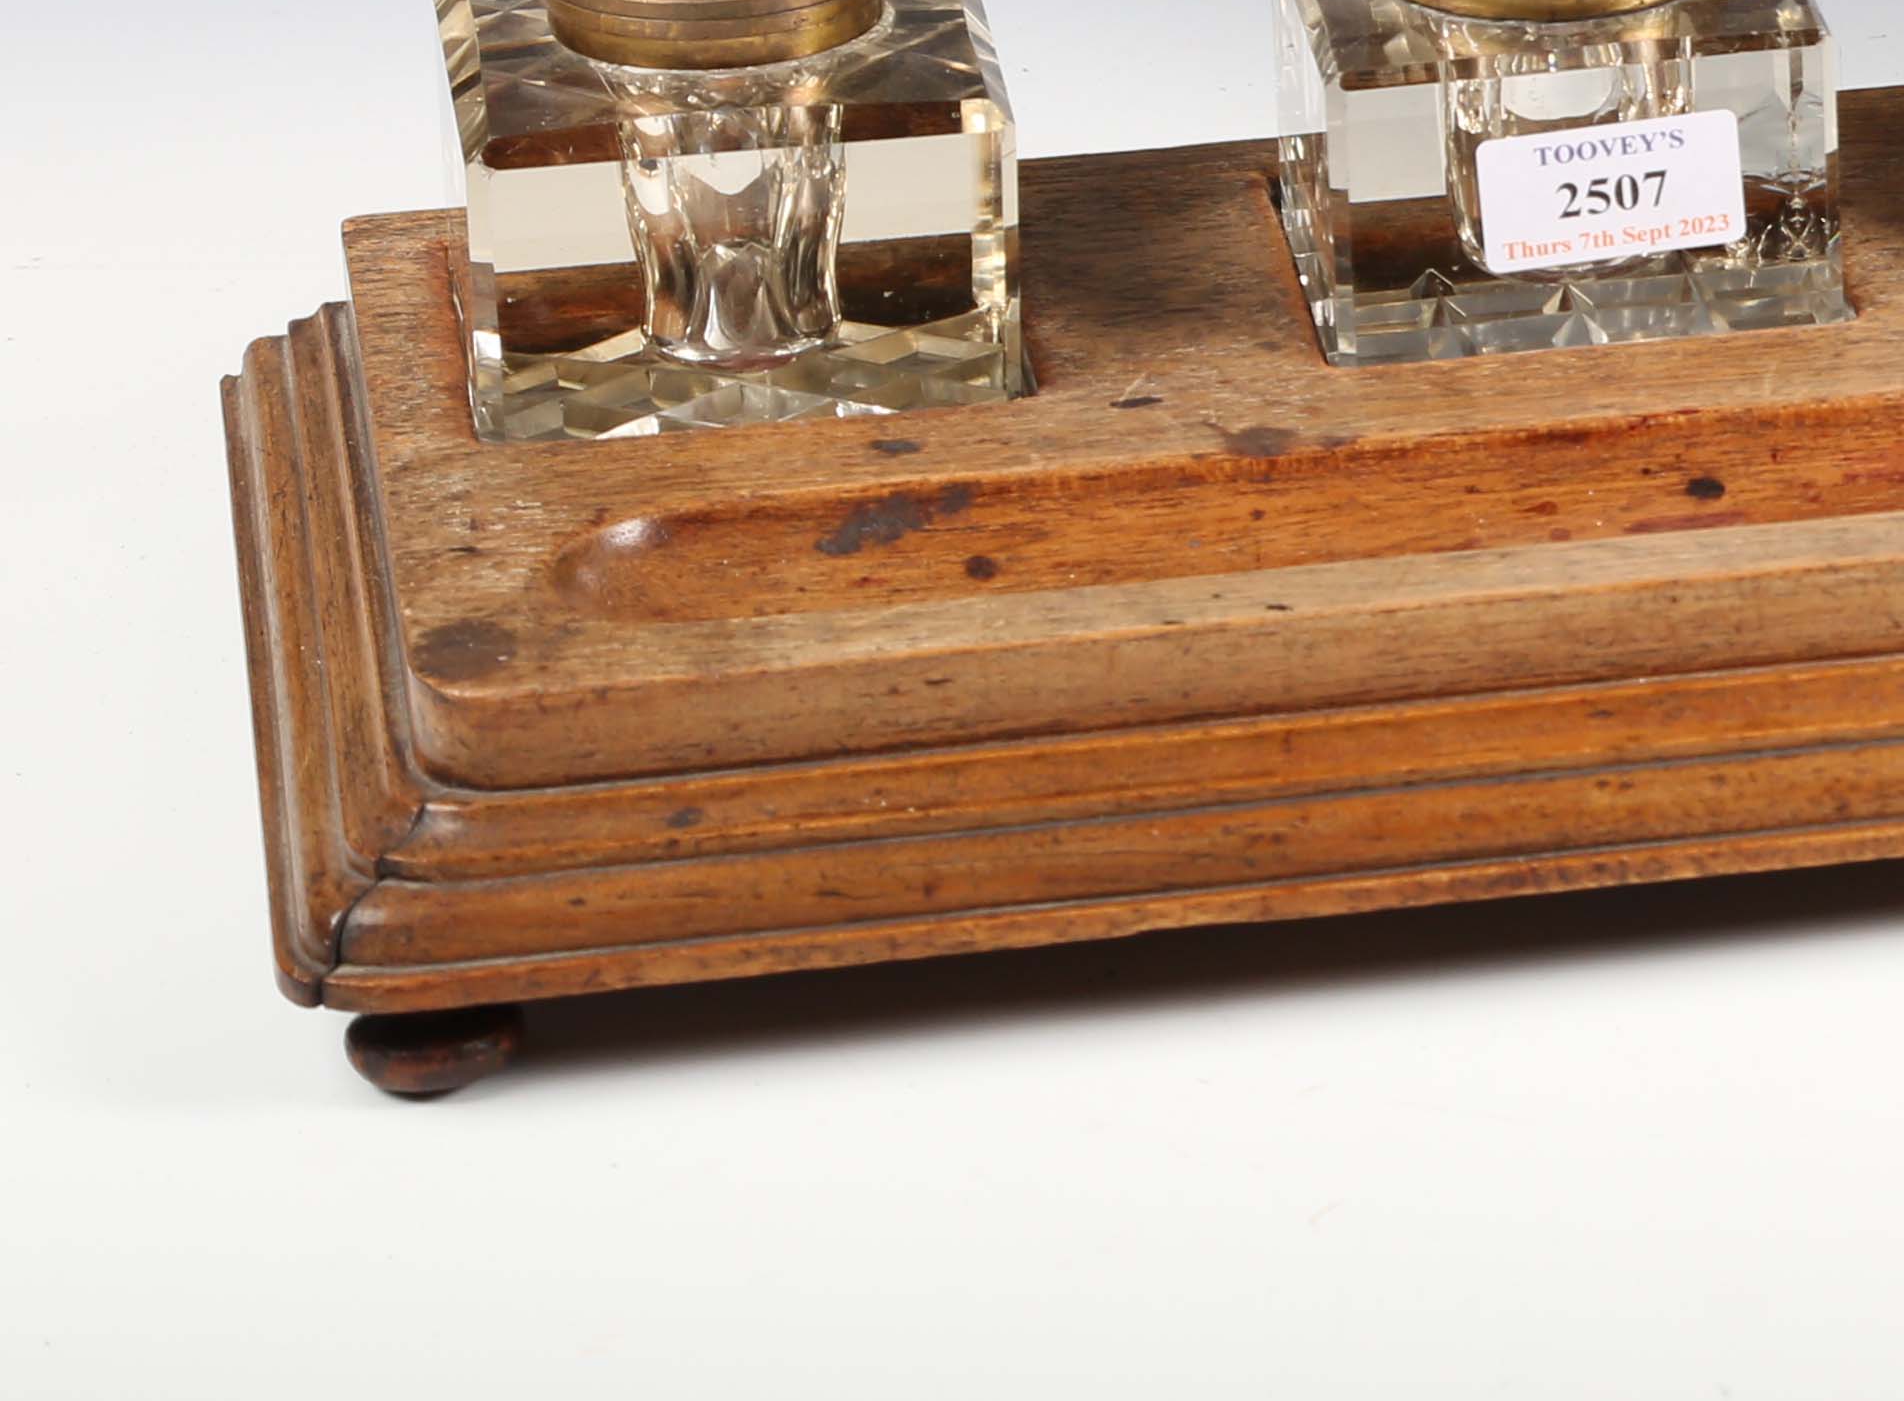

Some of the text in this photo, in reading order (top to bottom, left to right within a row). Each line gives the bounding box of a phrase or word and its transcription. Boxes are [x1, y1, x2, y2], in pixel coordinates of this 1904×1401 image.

[1533, 129, 1686, 166] TOOVEY'S
[1555, 169, 1668, 219] 2507
[1503, 214, 1730, 260] Thurs 7th Sept 2023
